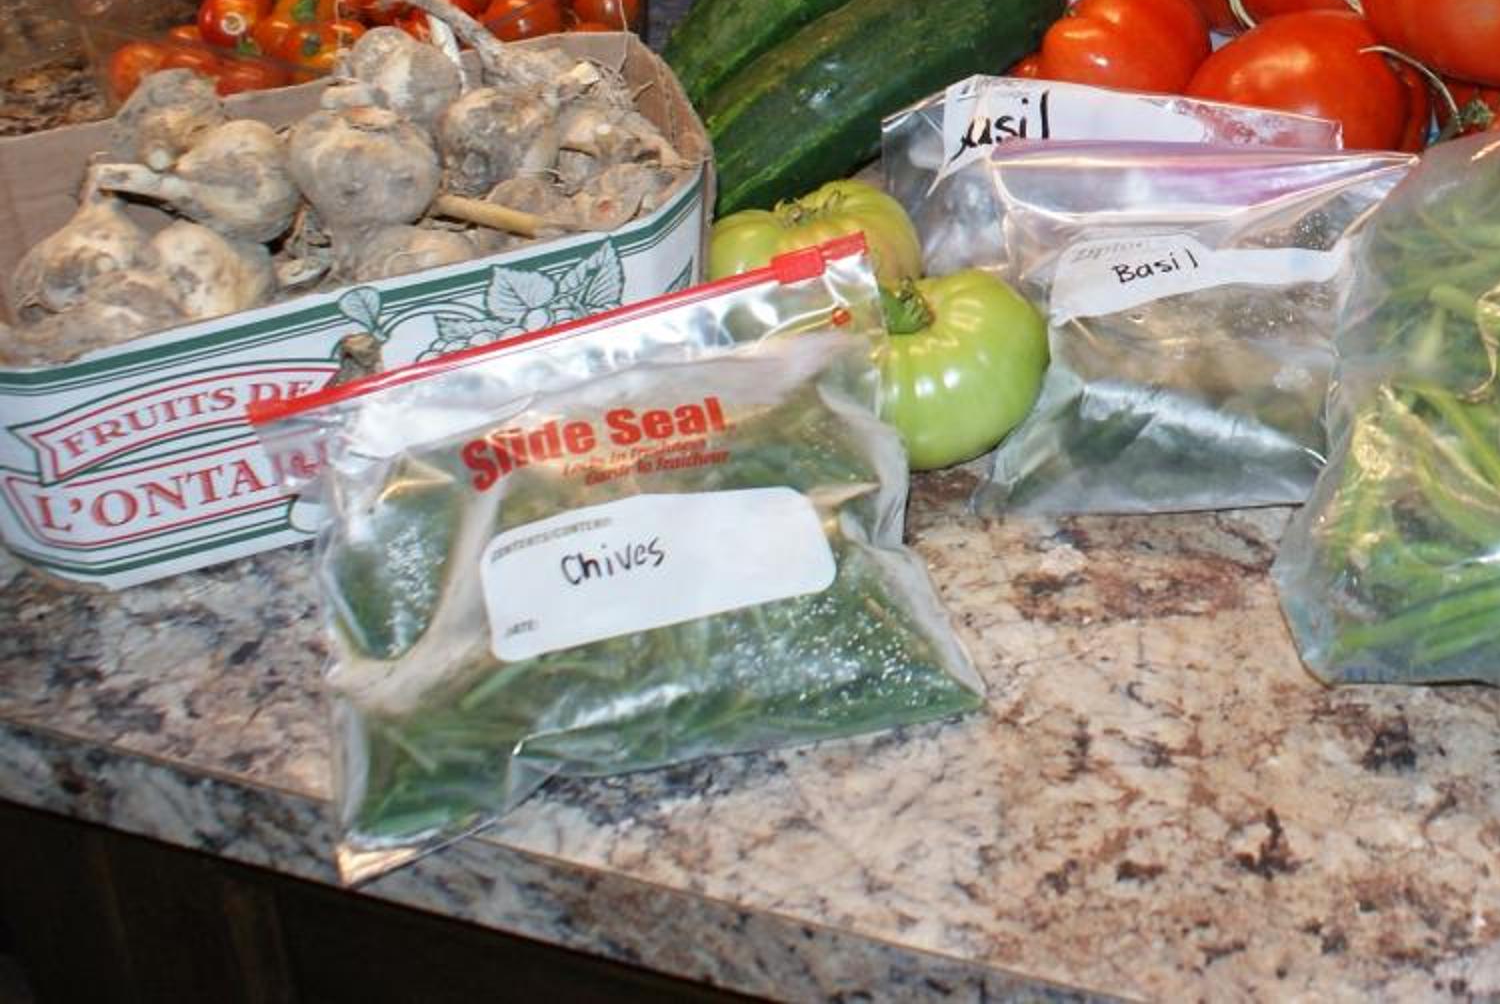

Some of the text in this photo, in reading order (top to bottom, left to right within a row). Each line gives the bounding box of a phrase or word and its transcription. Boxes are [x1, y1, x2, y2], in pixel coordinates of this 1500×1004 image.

[1112, 246, 1199, 284] Basil
[60, 383, 236, 458] FRUITS
[461, 419, 597, 492] Slide
[605, 396, 727, 446] Seal
[560, 537, 666, 586] Chives
